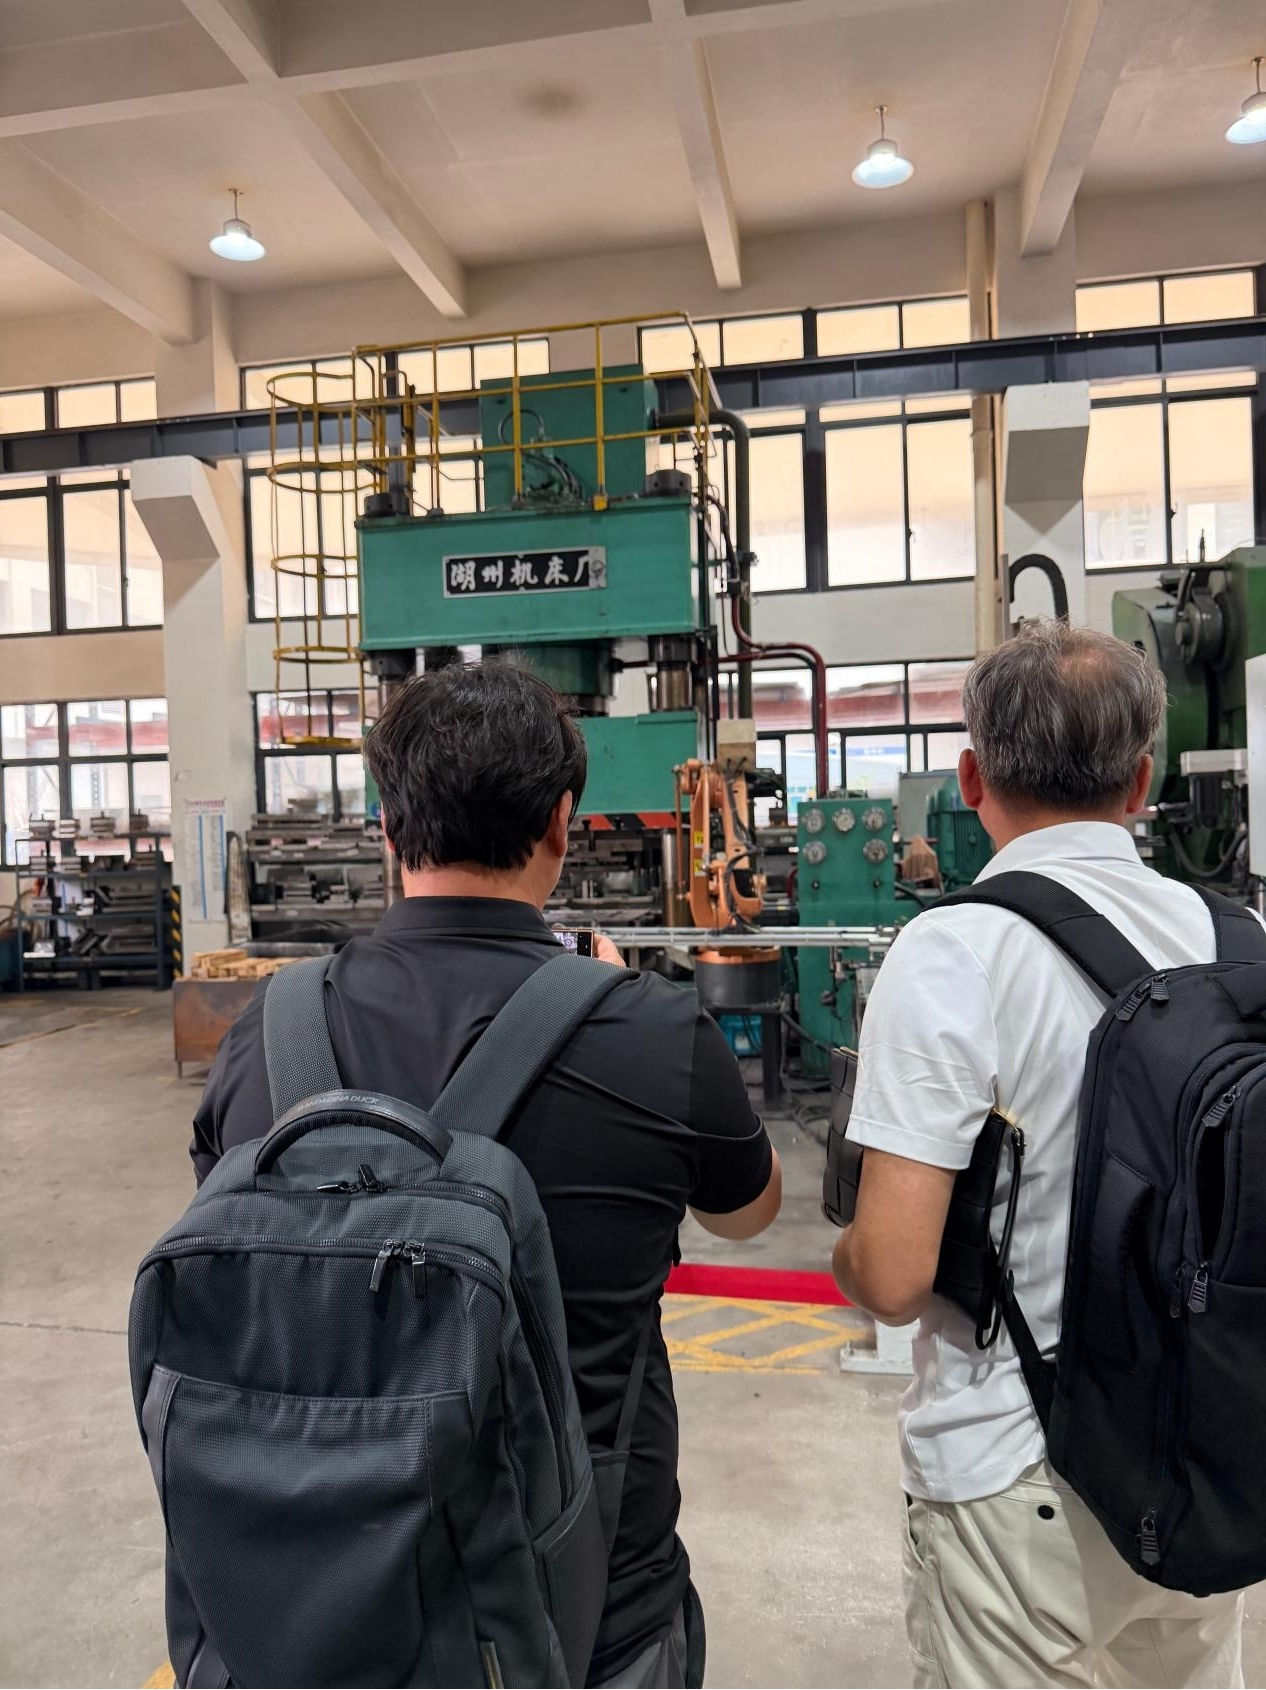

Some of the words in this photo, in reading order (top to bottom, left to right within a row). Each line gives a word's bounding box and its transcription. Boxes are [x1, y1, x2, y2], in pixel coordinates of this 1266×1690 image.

[450, 556, 589, 591] 湖州机床厂
[350, 1095, 379, 1105] DUCK
